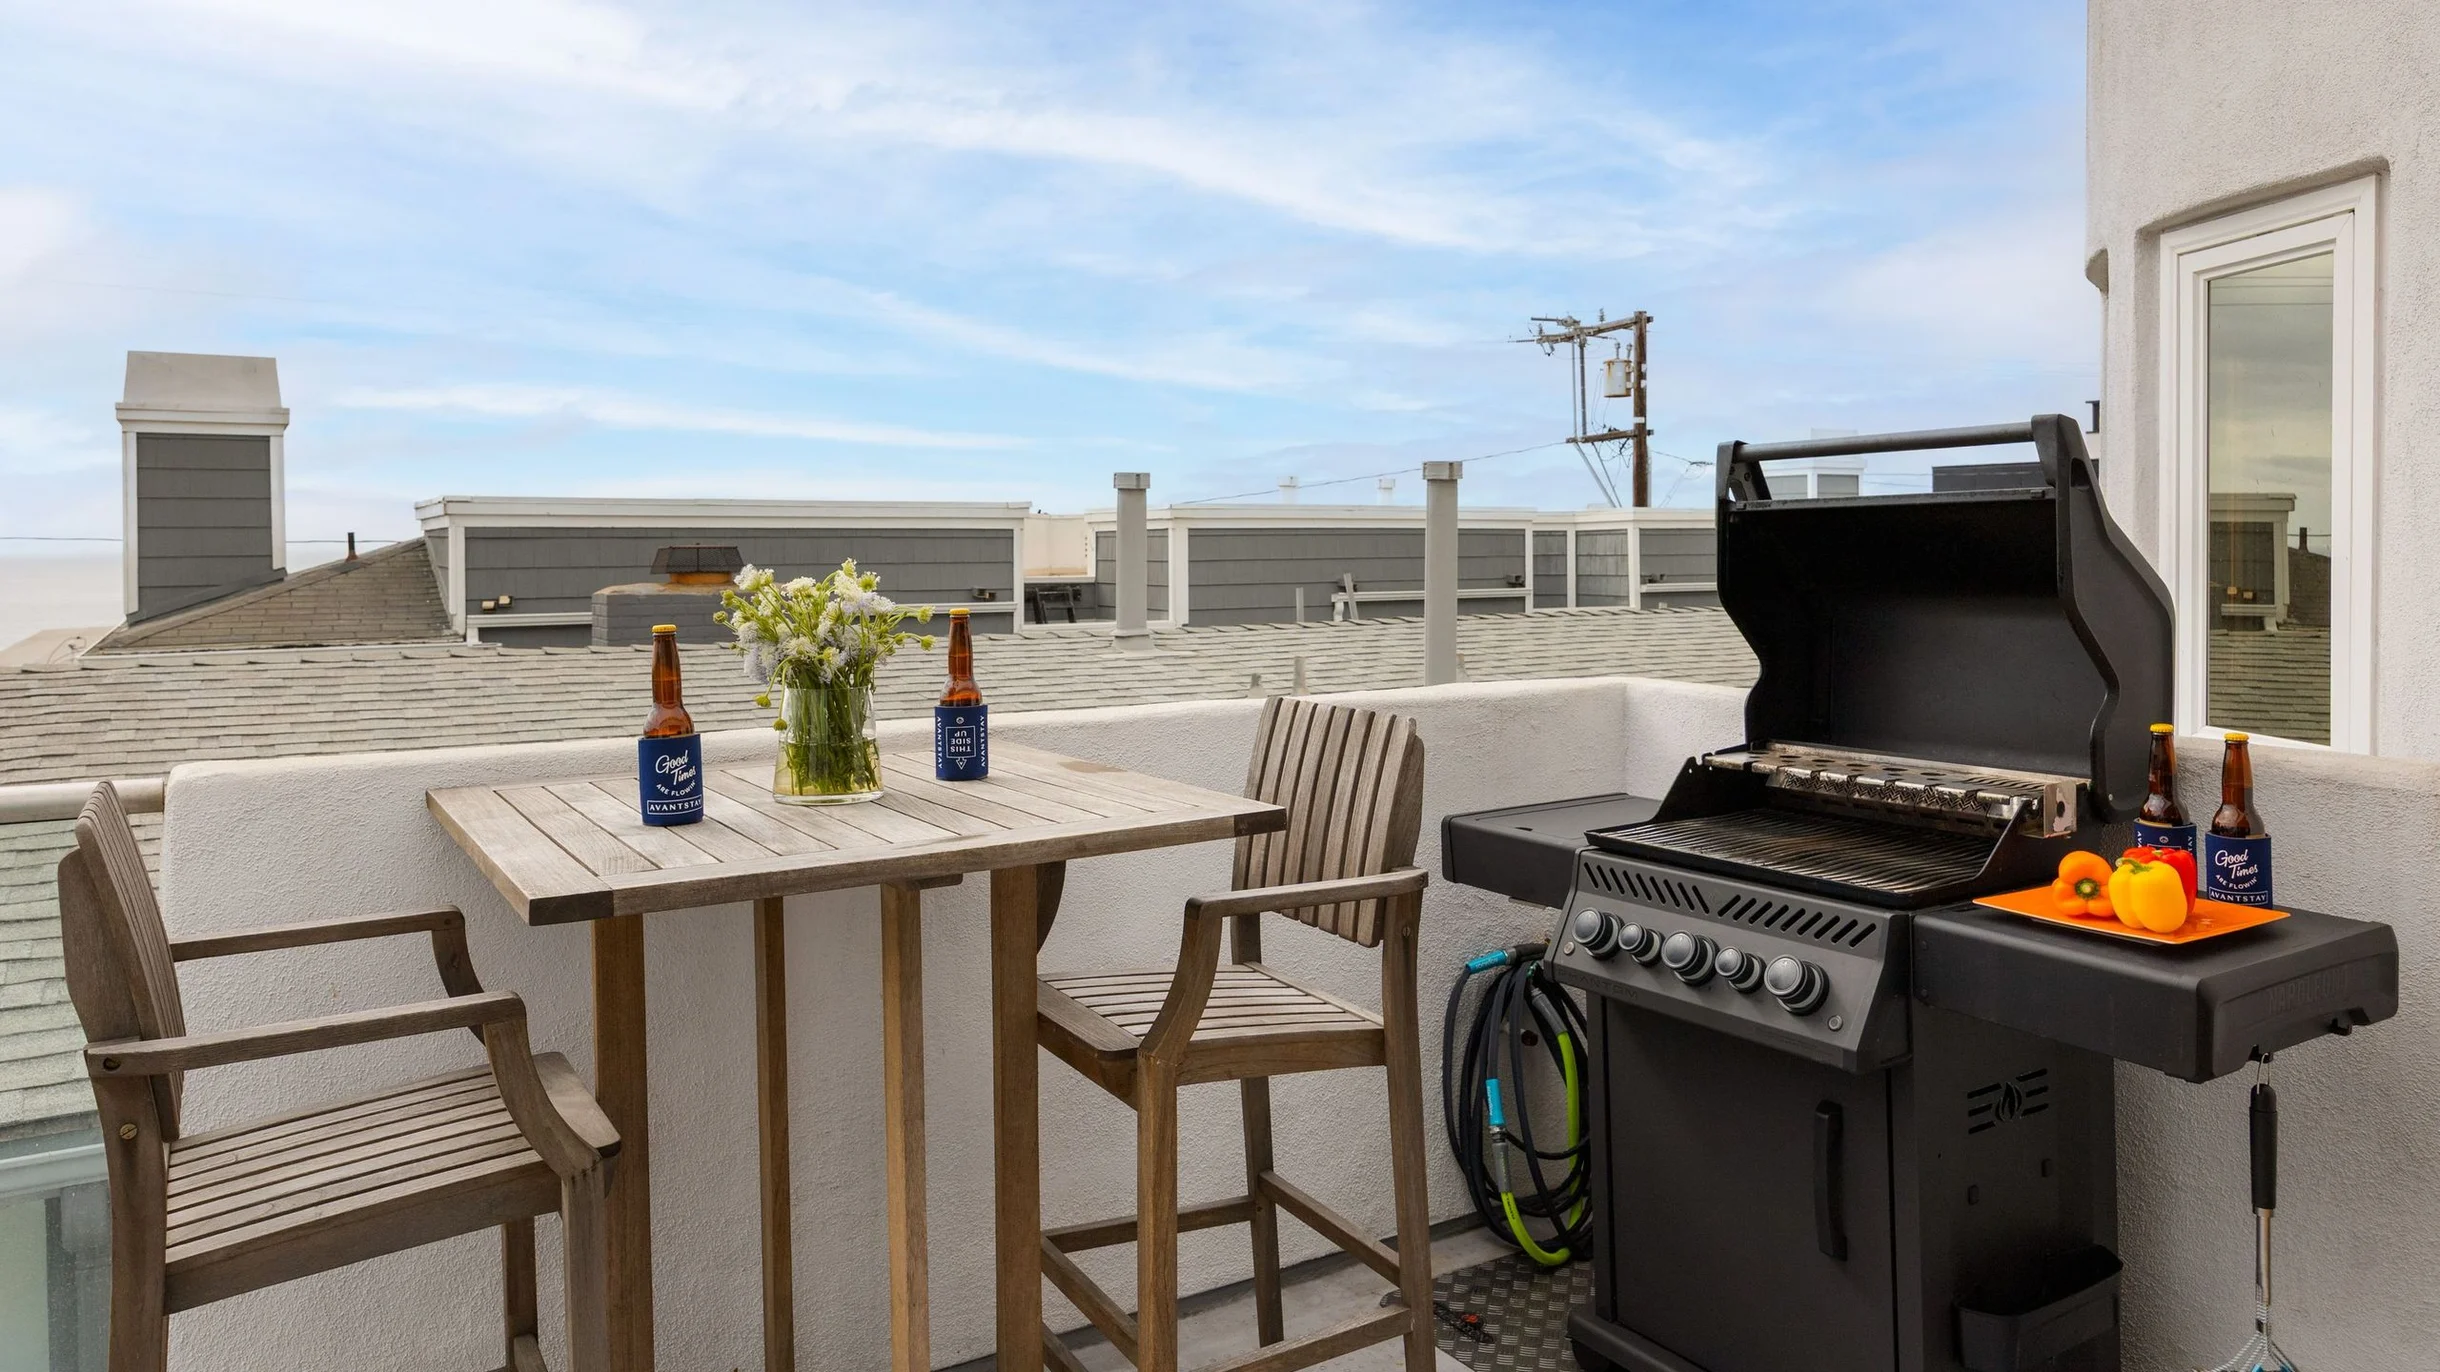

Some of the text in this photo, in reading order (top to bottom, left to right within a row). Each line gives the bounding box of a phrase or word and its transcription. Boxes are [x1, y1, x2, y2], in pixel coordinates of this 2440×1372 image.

[655, 749, 688, 774] Good
[670, 764, 696, 785] Times
[656, 783, 670, 795] ARE
[2215, 849, 2249, 868] Good
[2228, 864, 2258, 879] Times
[2215, 874, 2228, 886] ARE
[2210, 891, 2266, 902] AVANTSTAY
